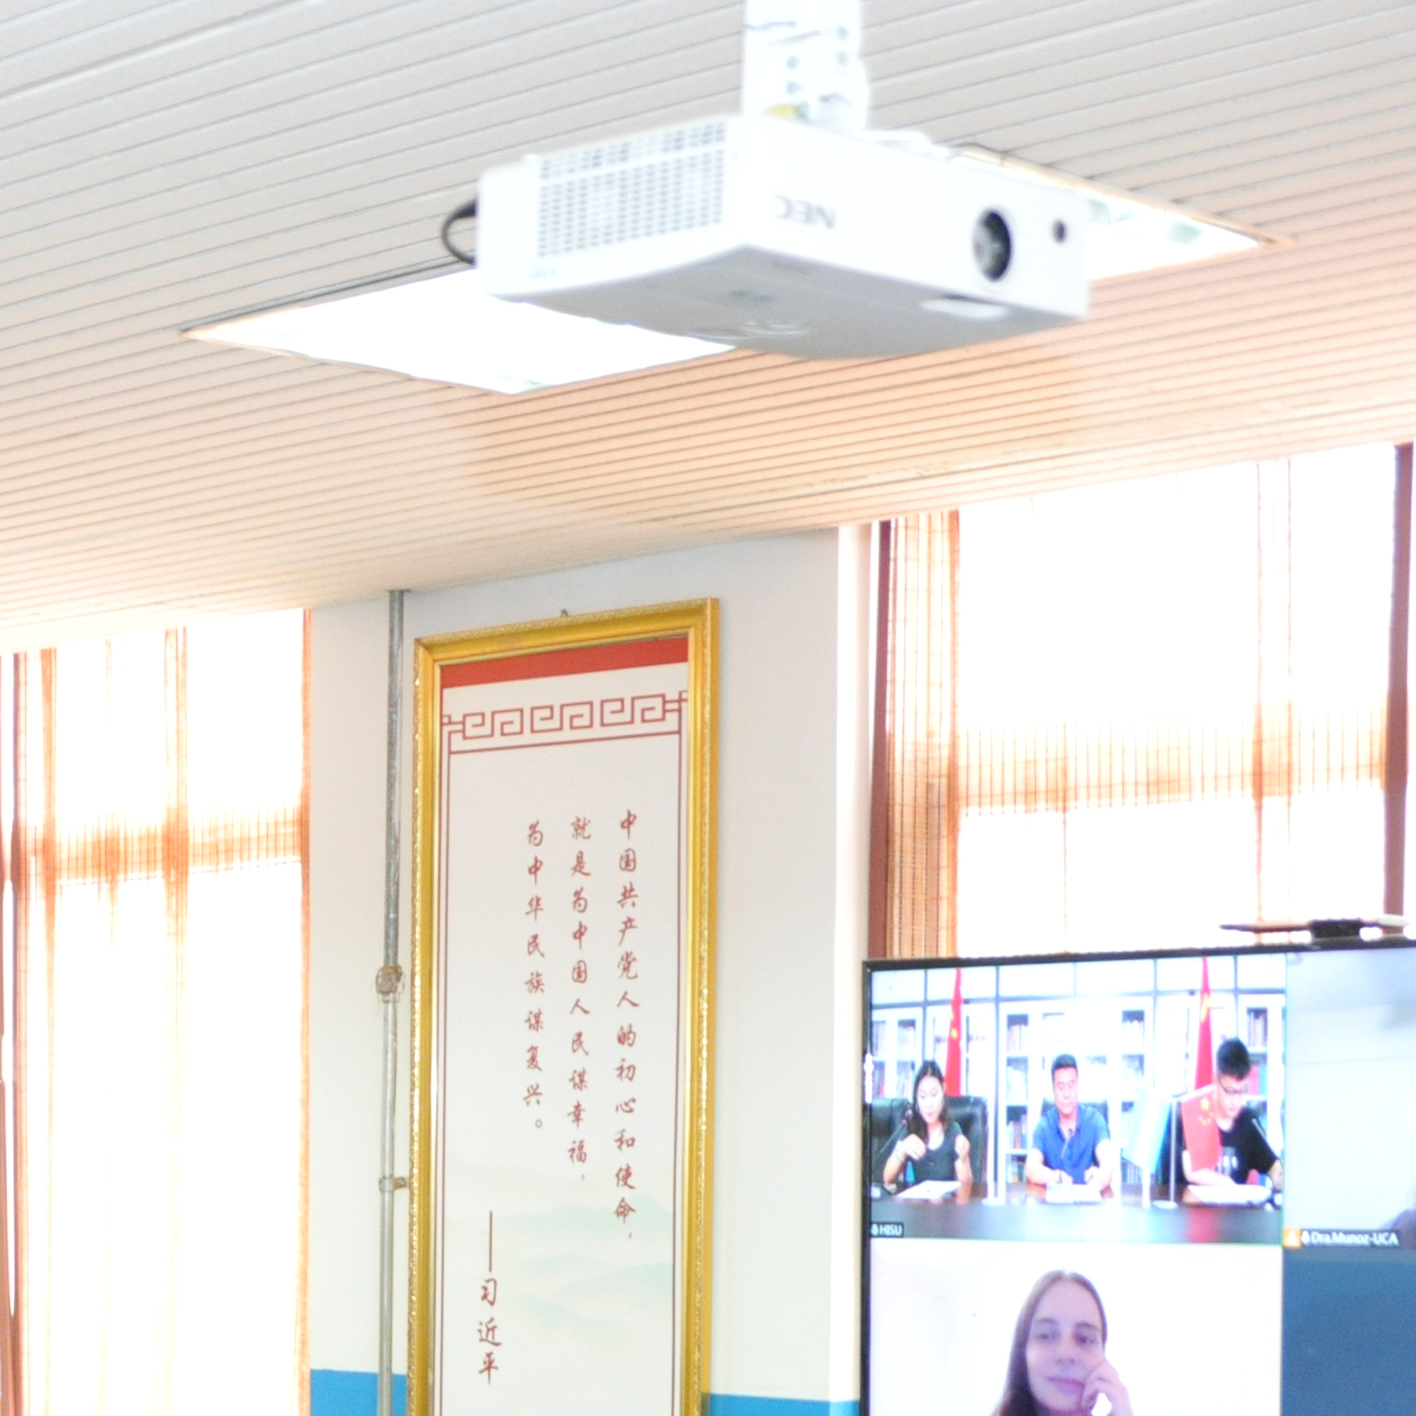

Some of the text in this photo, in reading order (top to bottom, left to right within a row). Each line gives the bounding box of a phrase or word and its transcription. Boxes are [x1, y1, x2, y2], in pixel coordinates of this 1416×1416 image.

[772, 194, 836, 230] NEC
[522, 819, 545, 1130] 为中华民族谋复兴。
